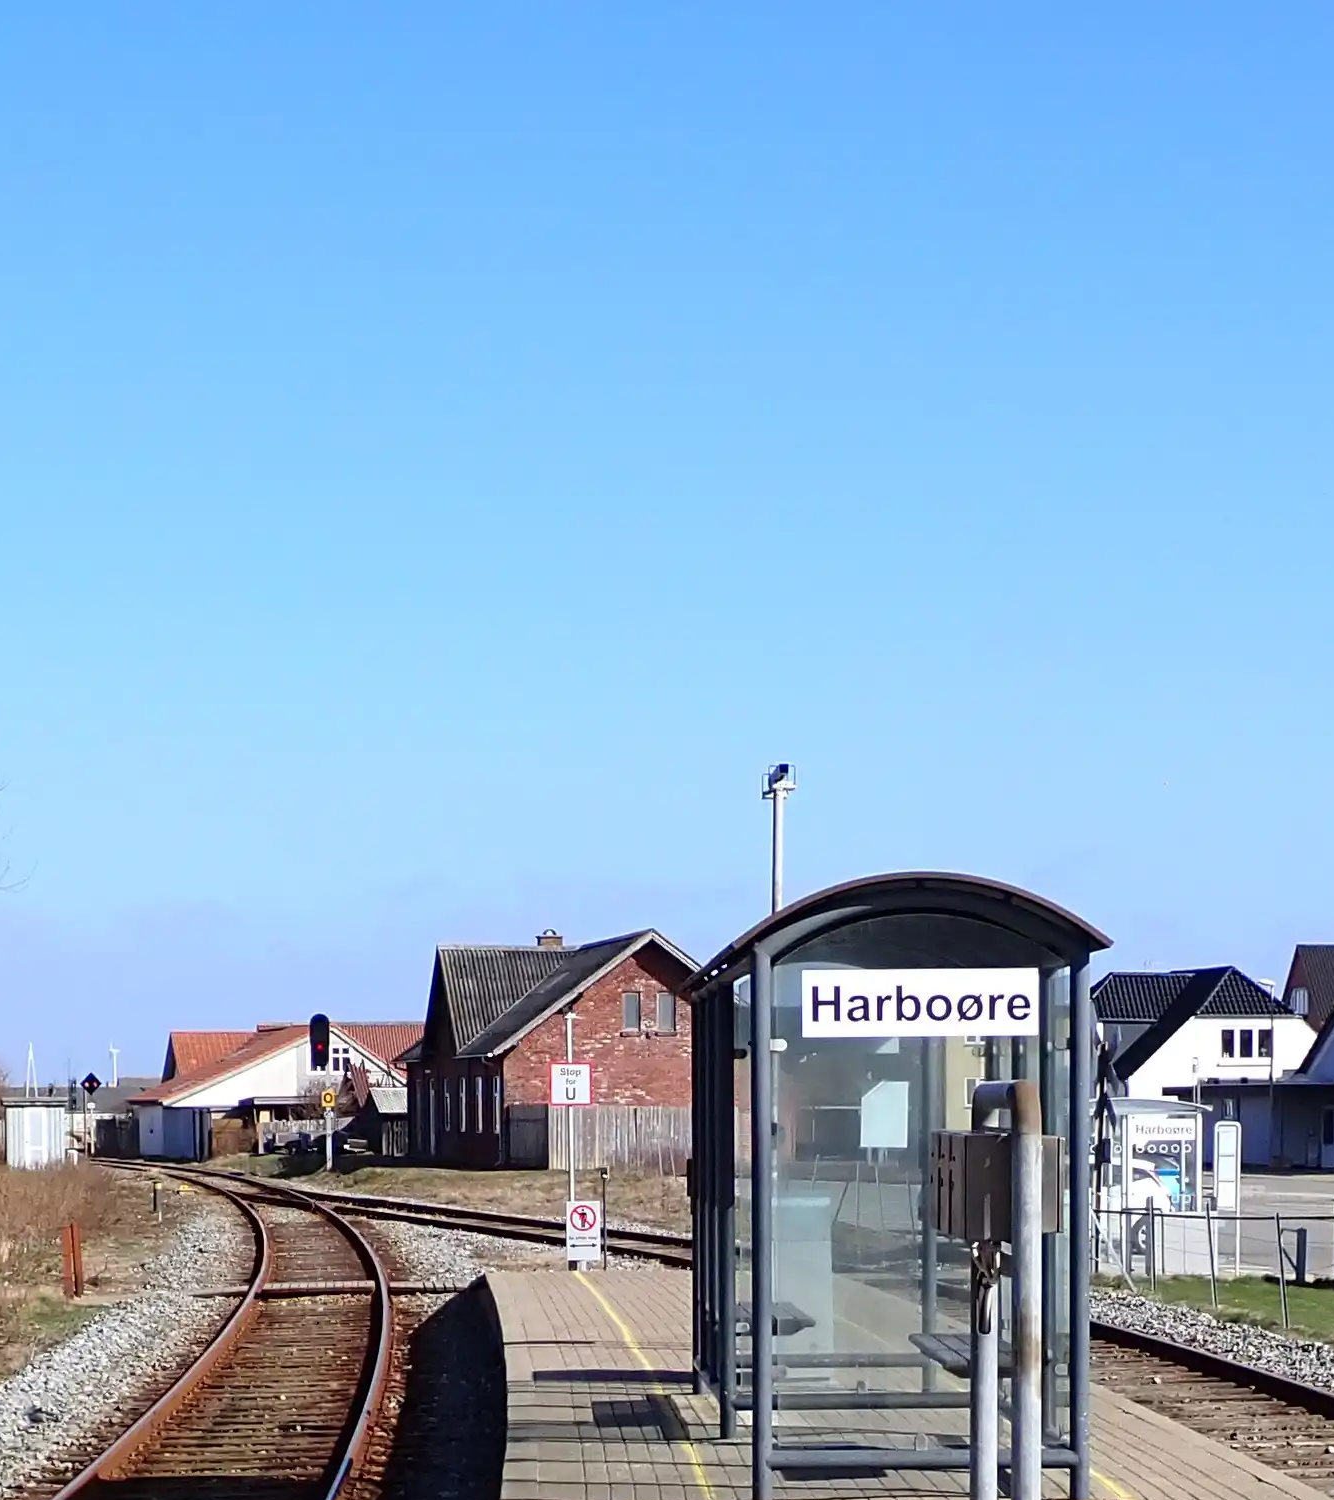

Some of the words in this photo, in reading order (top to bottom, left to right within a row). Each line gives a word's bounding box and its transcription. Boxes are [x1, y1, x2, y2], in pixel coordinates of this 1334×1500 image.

[812, 985, 1032, 1022] Harboøre
[560, 1067, 581, 1077] Stop
[565, 1087, 576, 1101] U
[1135, 1124, 1193, 1136] Harboøre
